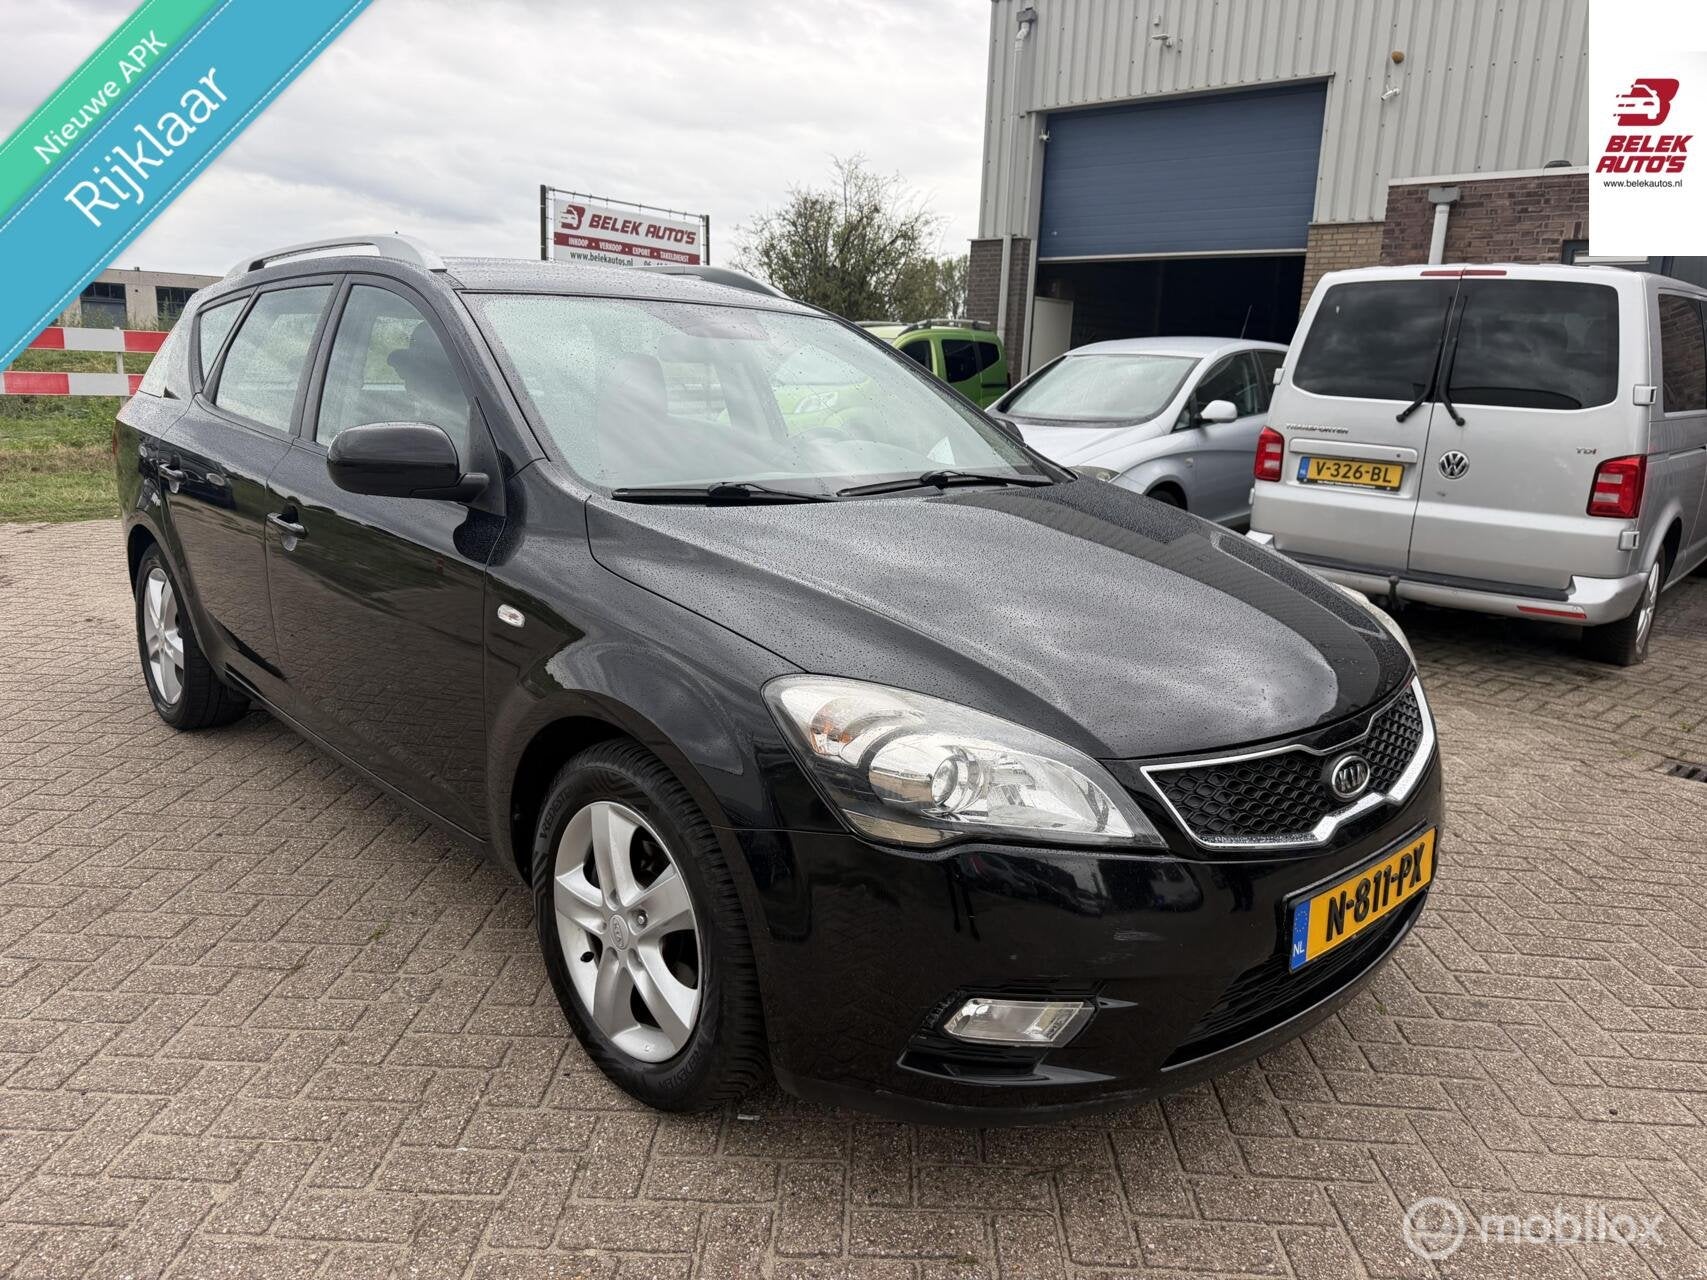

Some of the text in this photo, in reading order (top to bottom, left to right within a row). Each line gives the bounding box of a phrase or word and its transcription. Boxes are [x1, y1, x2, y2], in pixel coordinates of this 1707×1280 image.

[588, 213, 696, 245] BELEK AUTO'S
[568, 236, 589, 248] INKOOP
[598, 241, 623, 253] VERKOOP
[632, 246, 651, 257] EXPORT
[569, 251, 634, 267] www.belekautos.nl
[1285, 423, 1349, 434] TRANSPORTER
[1575, 447, 1598, 456] TDI
[1316, 461, 1392, 484] V-326-BL
[1326, 841, 1426, 943] N-811-PX
[1292, 940, 1305, 958] NL
